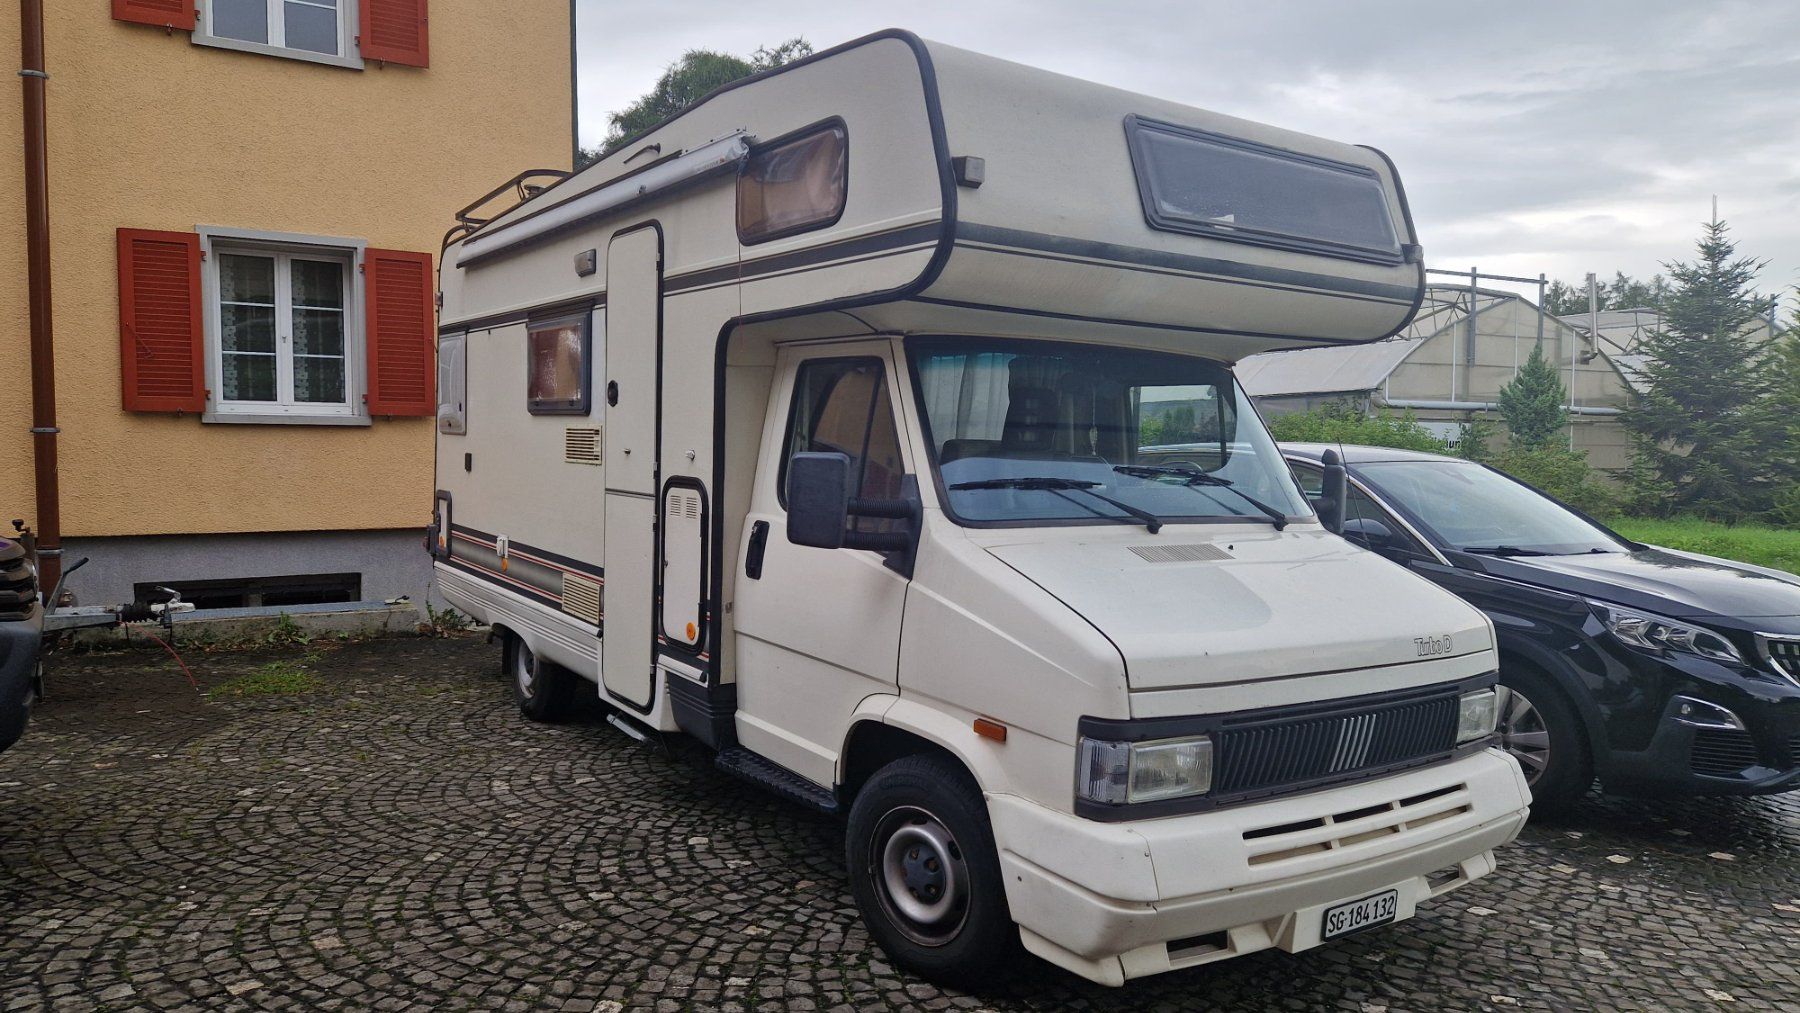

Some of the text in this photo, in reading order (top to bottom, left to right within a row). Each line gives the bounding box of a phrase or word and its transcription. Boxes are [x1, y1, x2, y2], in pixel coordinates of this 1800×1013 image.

[1413, 635, 1453, 656] Turbo D
[1373, 895, 1395, 920] 132
